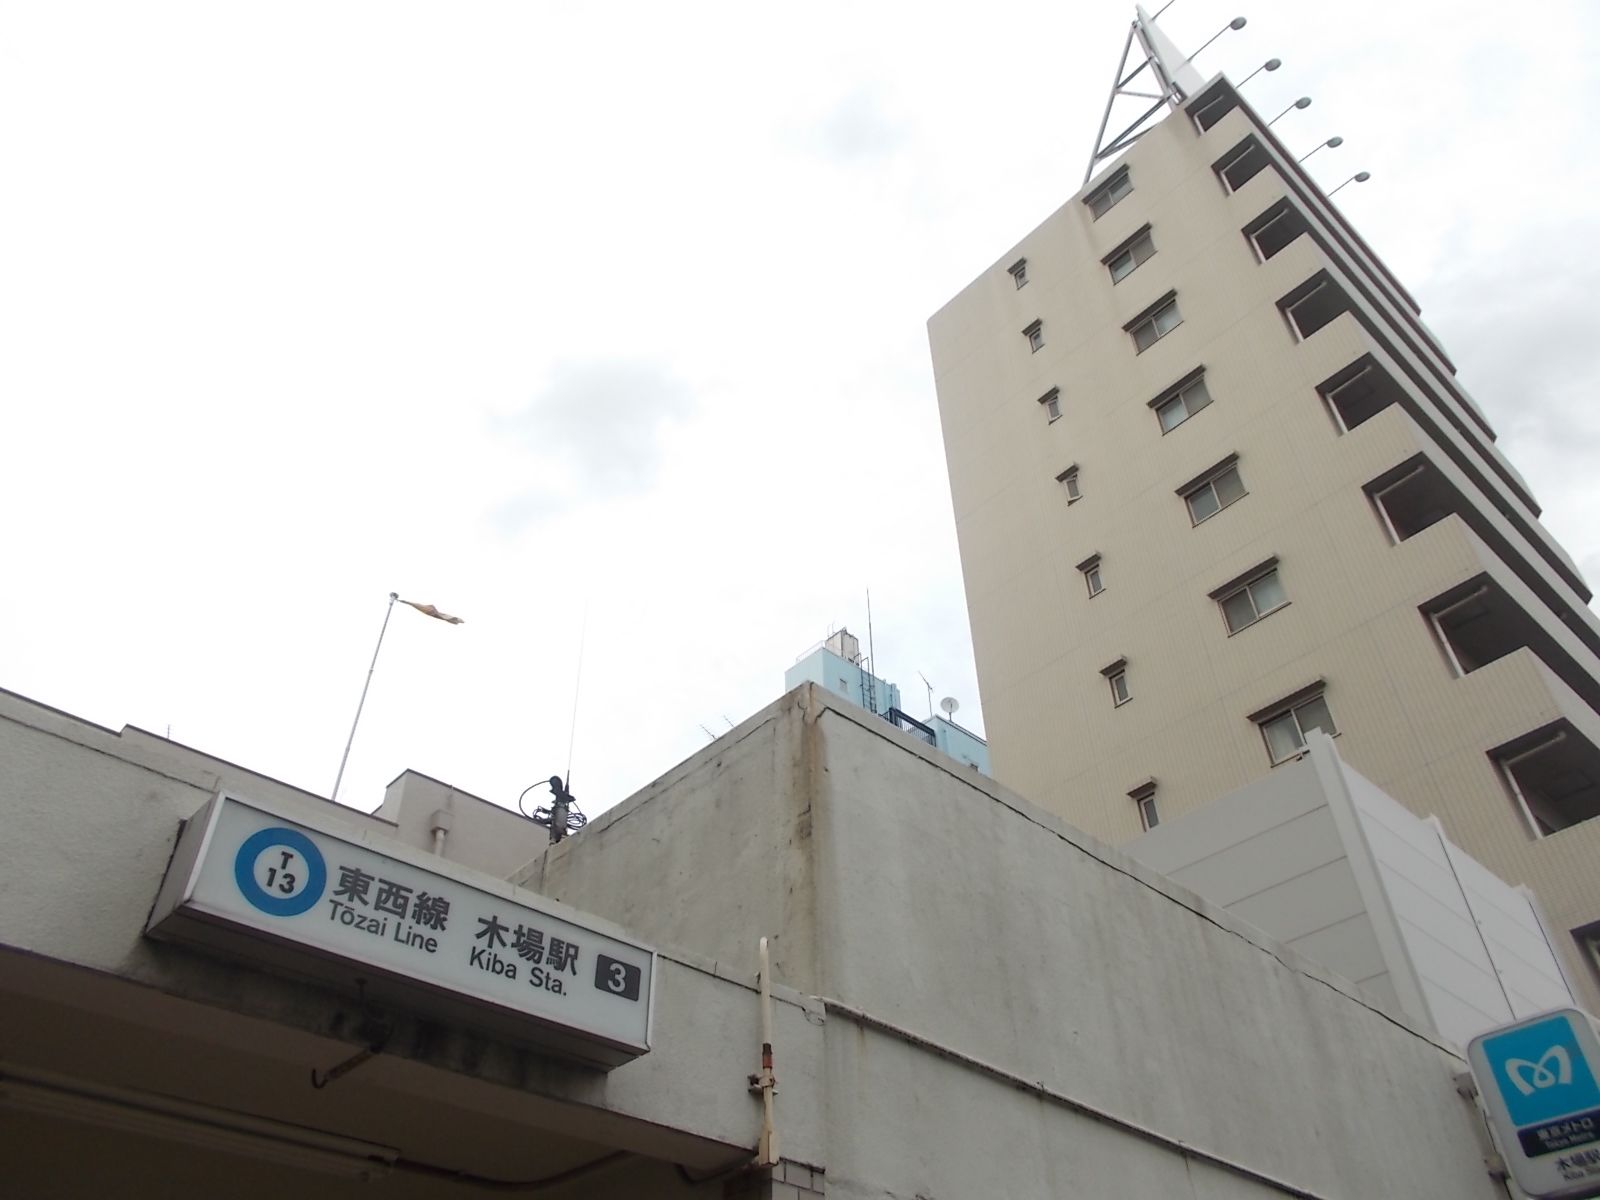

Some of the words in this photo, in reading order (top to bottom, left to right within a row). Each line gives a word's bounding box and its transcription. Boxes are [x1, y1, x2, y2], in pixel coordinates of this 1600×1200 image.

[281, 851, 293, 870] T
[265, 867, 296, 894] 13
[332, 865, 450, 932] 東西線
[475, 915, 580, 976] 木場駅
[393, 921, 438, 953] Line
[470, 946, 518, 981] Kiba
[529, 966, 567, 996] Sta.
[607, 962, 626, 993] 3
